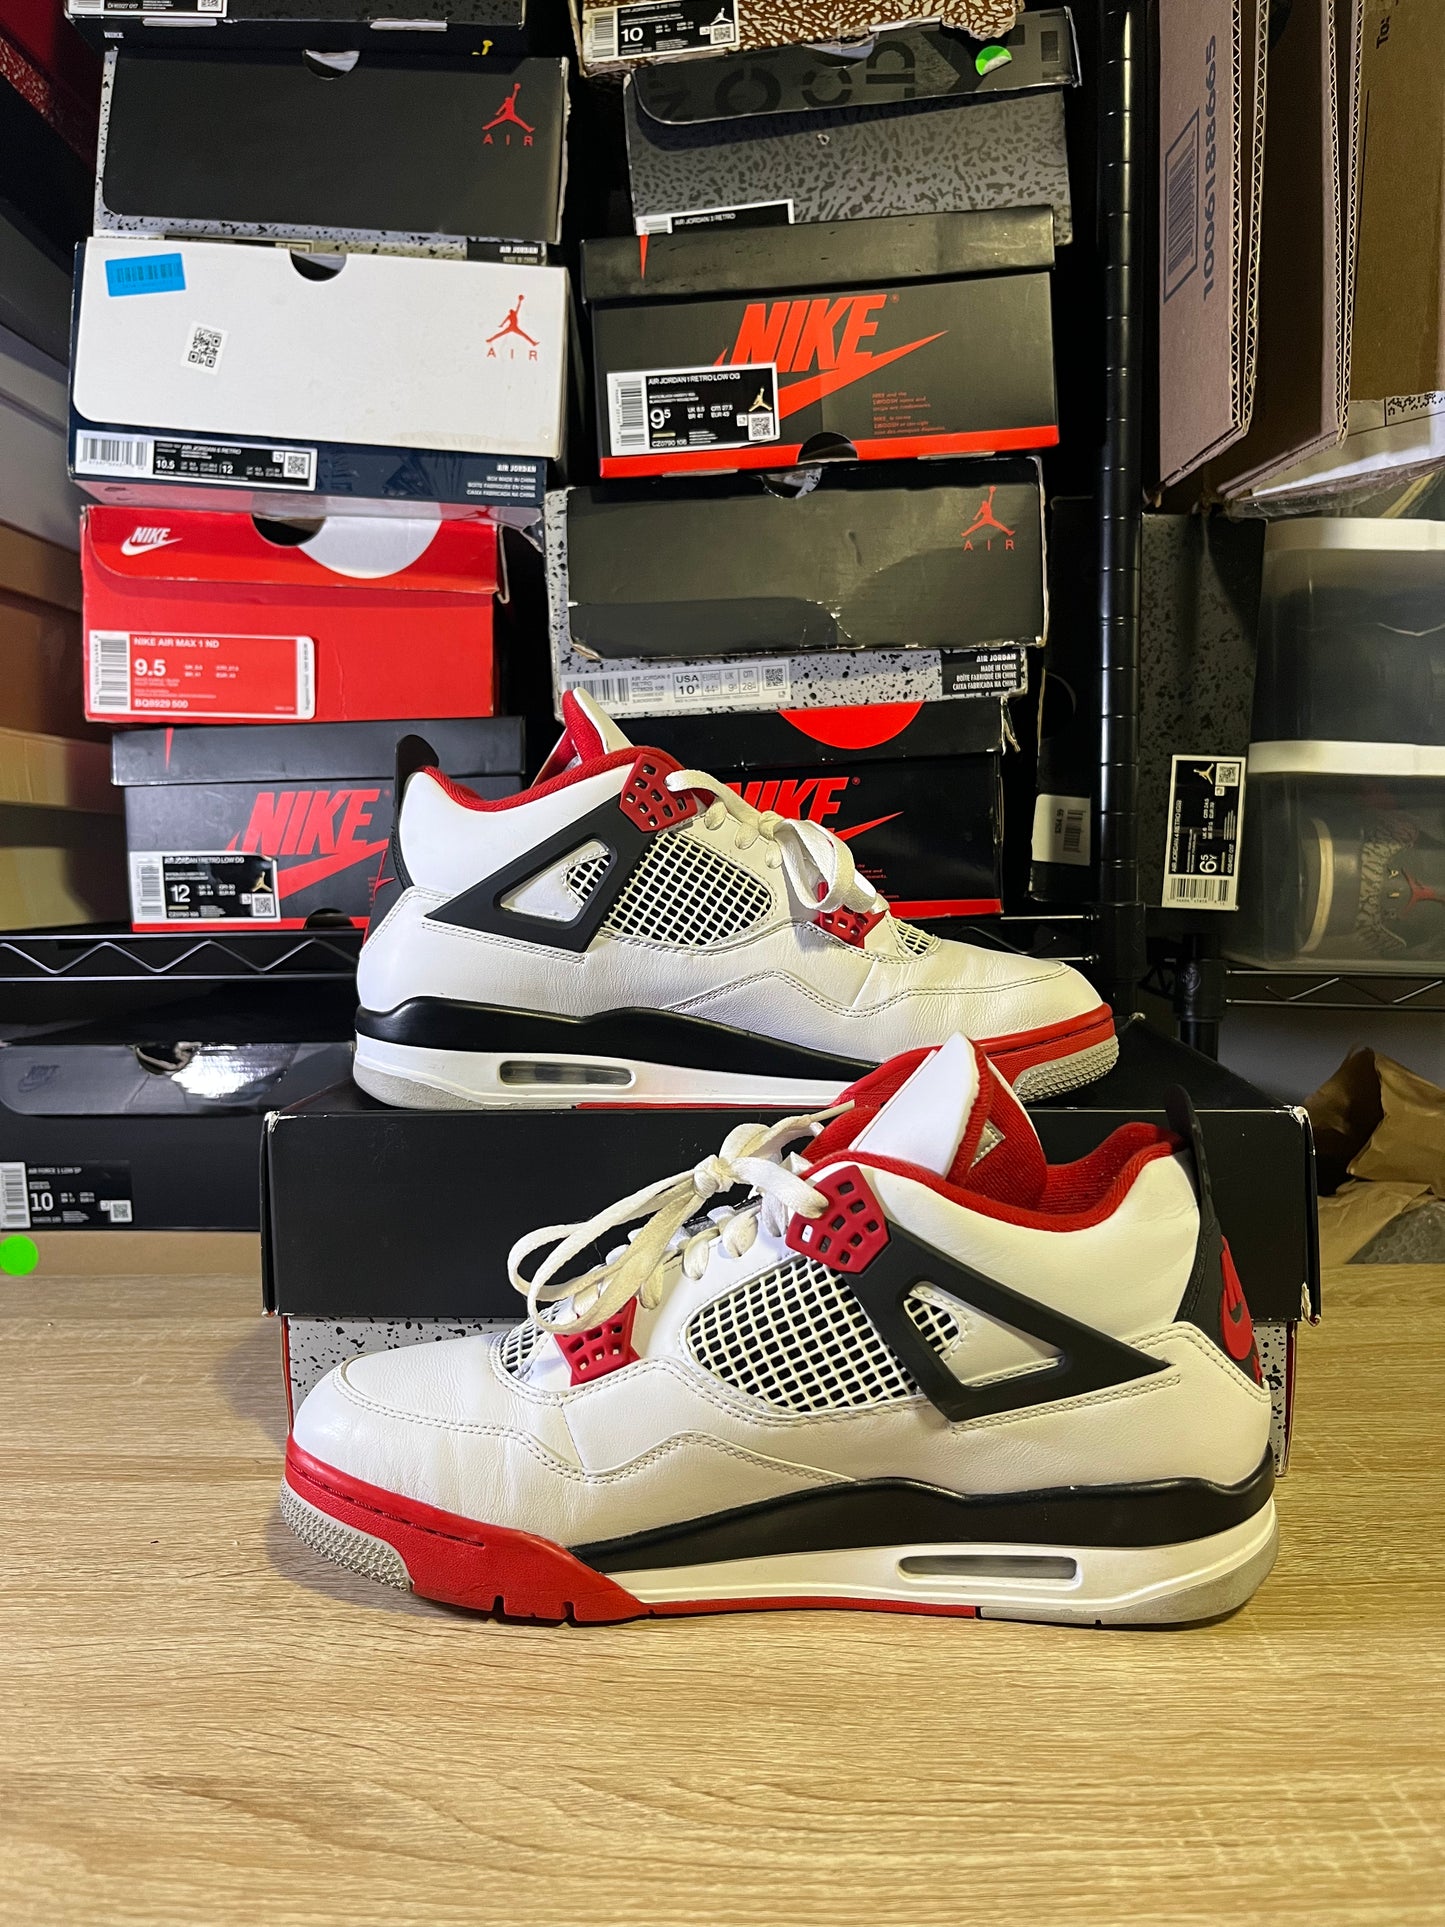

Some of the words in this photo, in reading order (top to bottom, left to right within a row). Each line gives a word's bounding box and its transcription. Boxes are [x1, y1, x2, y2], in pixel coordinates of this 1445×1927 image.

[620, 27, 644, 42] 10
[1376, 15, 1391, 50] To:
[482, 134, 534, 147] AIR
[1203, 35, 1216, 301] 1006188665
[730, 294, 887, 373] NIKE
[487, 348, 538, 361] AIR
[648, 377, 660, 385] AIR
[660, 376, 686, 384] JORDAN
[690, 374, 713, 383] RETRO
[713, 373, 729, 381] LOW
[729, 372, 740, 380] OG
[155, 459, 175, 470] 10.5
[222, 464, 233, 474] 12
[496, 463, 509, 472] AIR
[510, 464, 537, 473] JORDAN
[130, 526, 171, 544] NIKE
[963, 539, 1015, 552] AIR
[134, 637, 156, 647] NIKE
[157, 638, 174, 647] AIR
[175, 639, 196, 648] MAX
[205, 640, 220, 649] ND
[976, 655, 988, 663] AIR
[989, 653, 1017, 662] JORDAN
[134, 658, 166, 677] 9.5
[980, 664, 994, 672] MADE
[675, 674, 700, 683] USA
[724, 671, 734, 680] UK
[1001, 671, 1017, 679] CHINE
[952, 682, 967, 691] CAIXA
[967, 681, 994, 689] FABRICADA
[242, 788, 381, 856] NIKE
[170, 884, 191, 903] 12
[30, 1192, 54, 1211] 10
